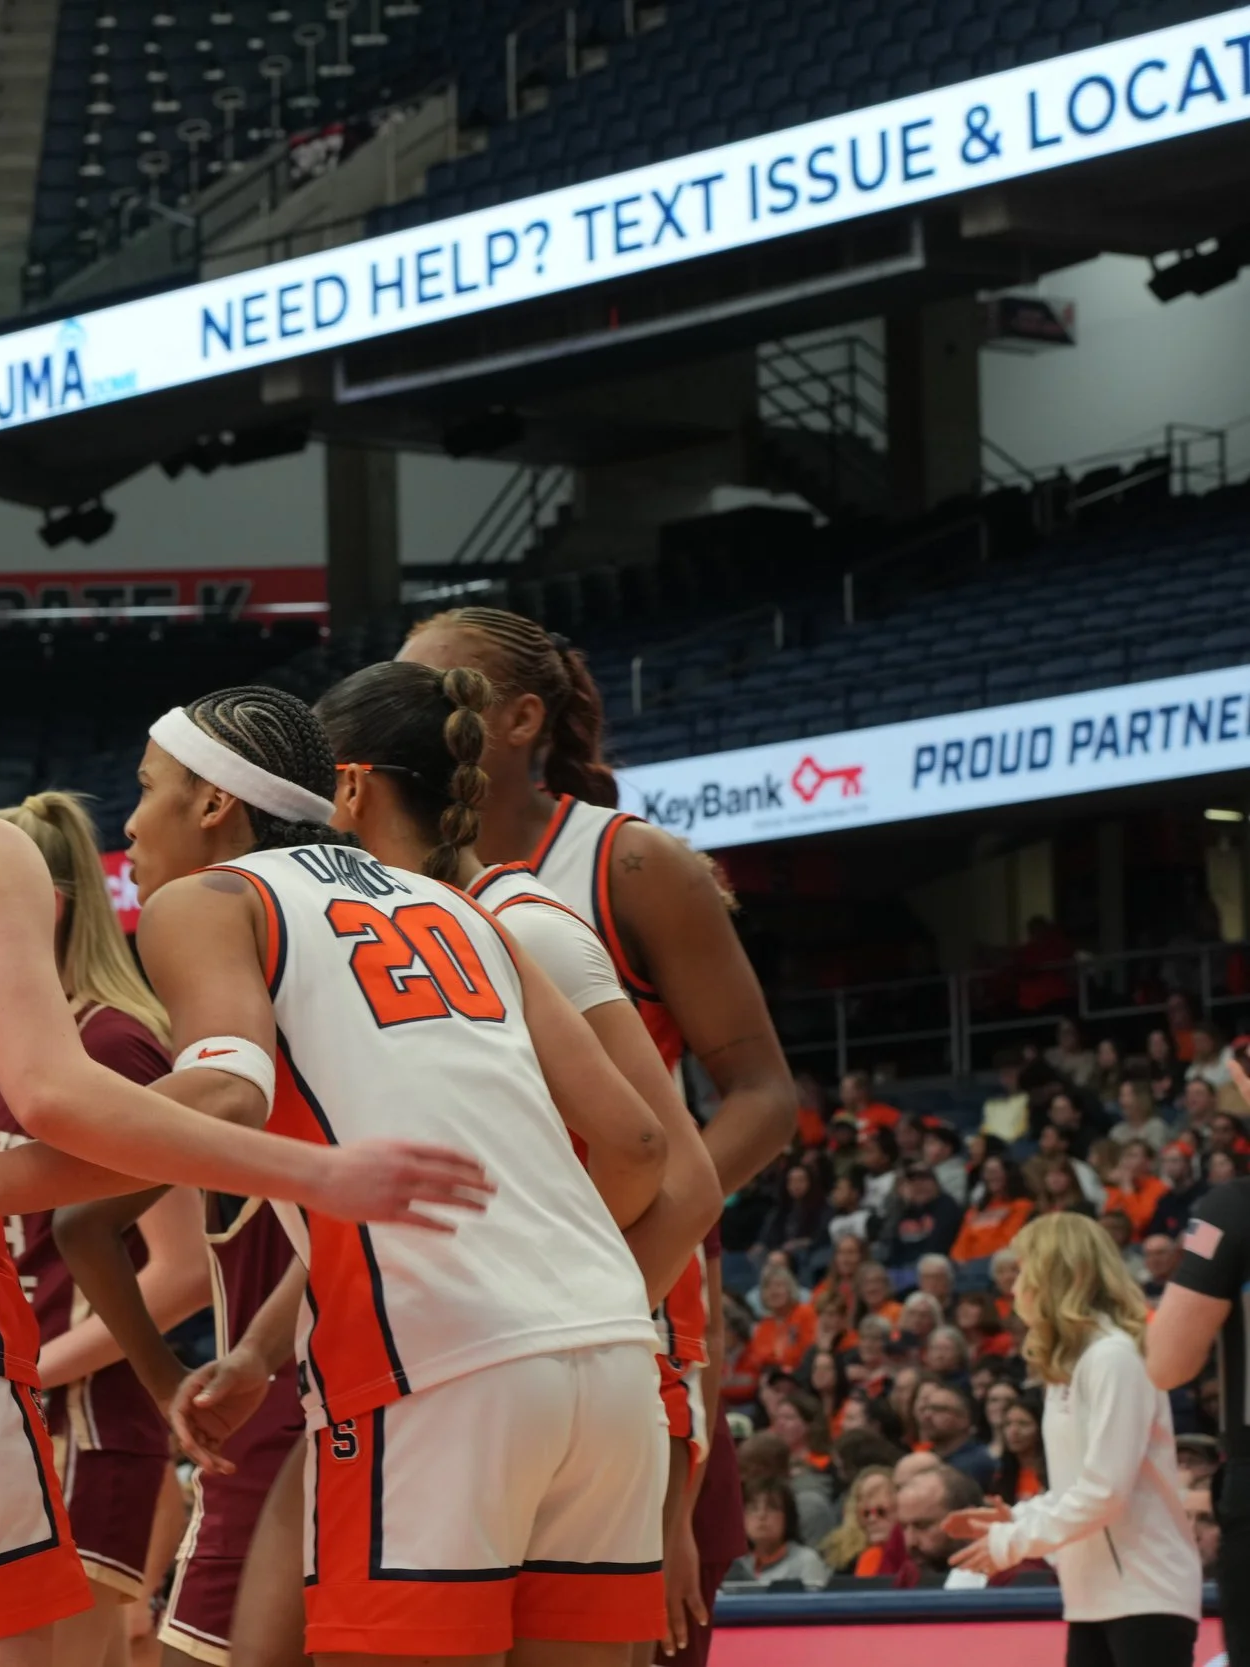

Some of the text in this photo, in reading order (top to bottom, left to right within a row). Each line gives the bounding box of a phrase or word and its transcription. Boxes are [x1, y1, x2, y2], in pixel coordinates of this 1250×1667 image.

[201, 34, 1250, 359] NEED HELP? TEXT ISSUE & LOCAT
[912, 694, 1250, 789] PROUD PARTNE
[641, 772, 784, 830] KeyBank
[325, 898, 507, 1028] 20
